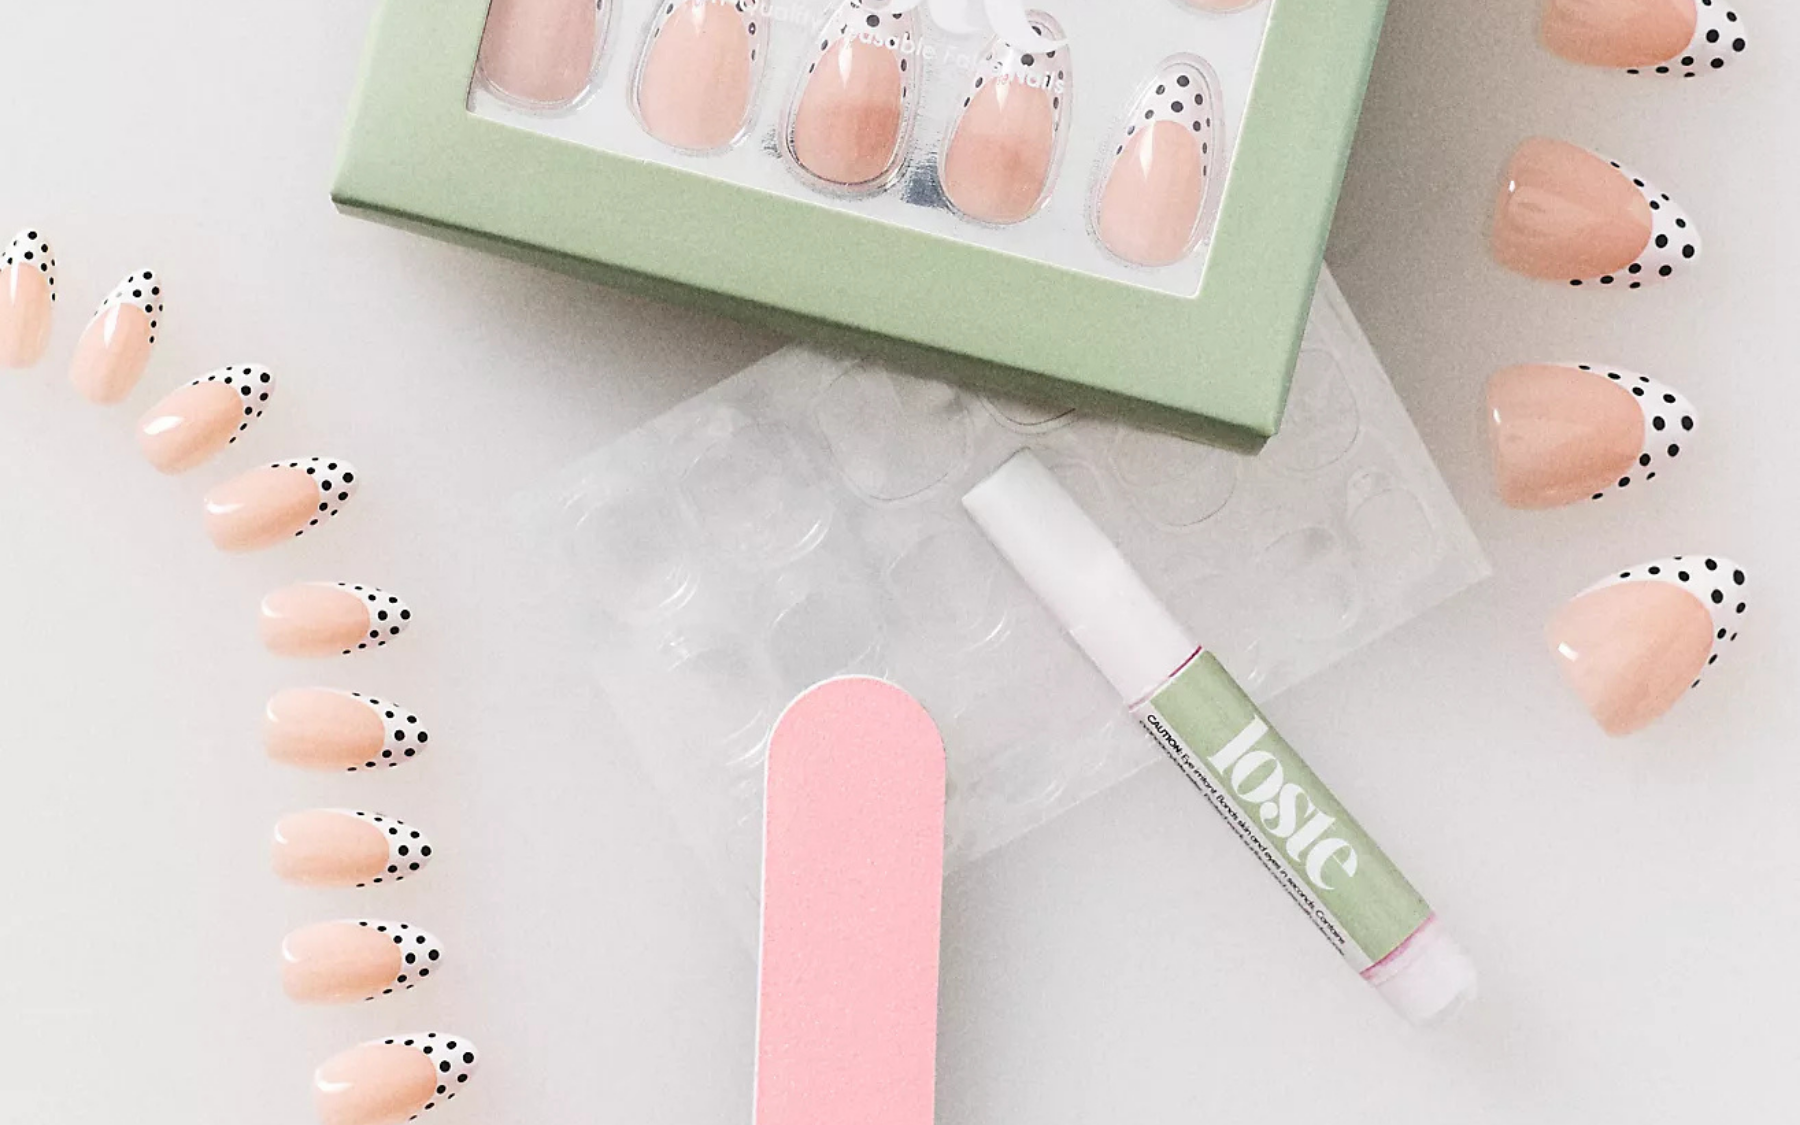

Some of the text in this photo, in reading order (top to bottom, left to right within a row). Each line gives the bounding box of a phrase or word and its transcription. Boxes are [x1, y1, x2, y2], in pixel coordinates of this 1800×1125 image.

[1145, 712, 1185, 755] CAUTION:
[1179, 752, 1196, 770] Eye
[1237, 817, 1253, 835] skin
[1249, 833, 1267, 852] and
[1280, 868, 1289, 878] in
[1207, 714, 1358, 890] loste
